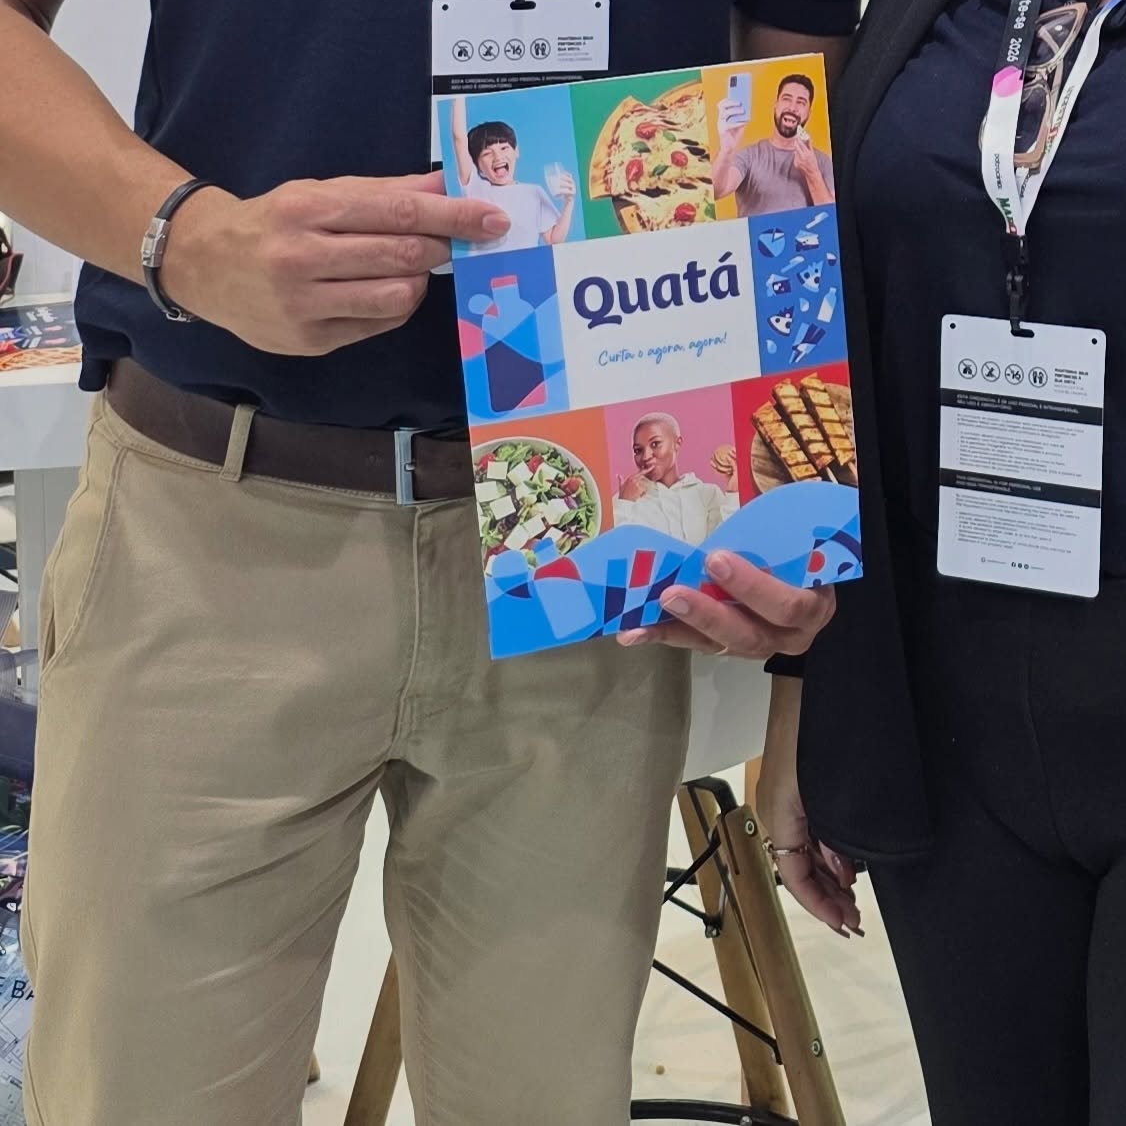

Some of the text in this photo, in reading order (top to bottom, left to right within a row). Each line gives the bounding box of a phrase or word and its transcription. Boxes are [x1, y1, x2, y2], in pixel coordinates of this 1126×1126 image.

[1006, 37, 1023, 63] 2026
[573, 251, 741, 330] Quatá
[598, 349, 635, 367] Curta
[637, 350, 644, 359] o
[688, 331, 728, 358] agora!
